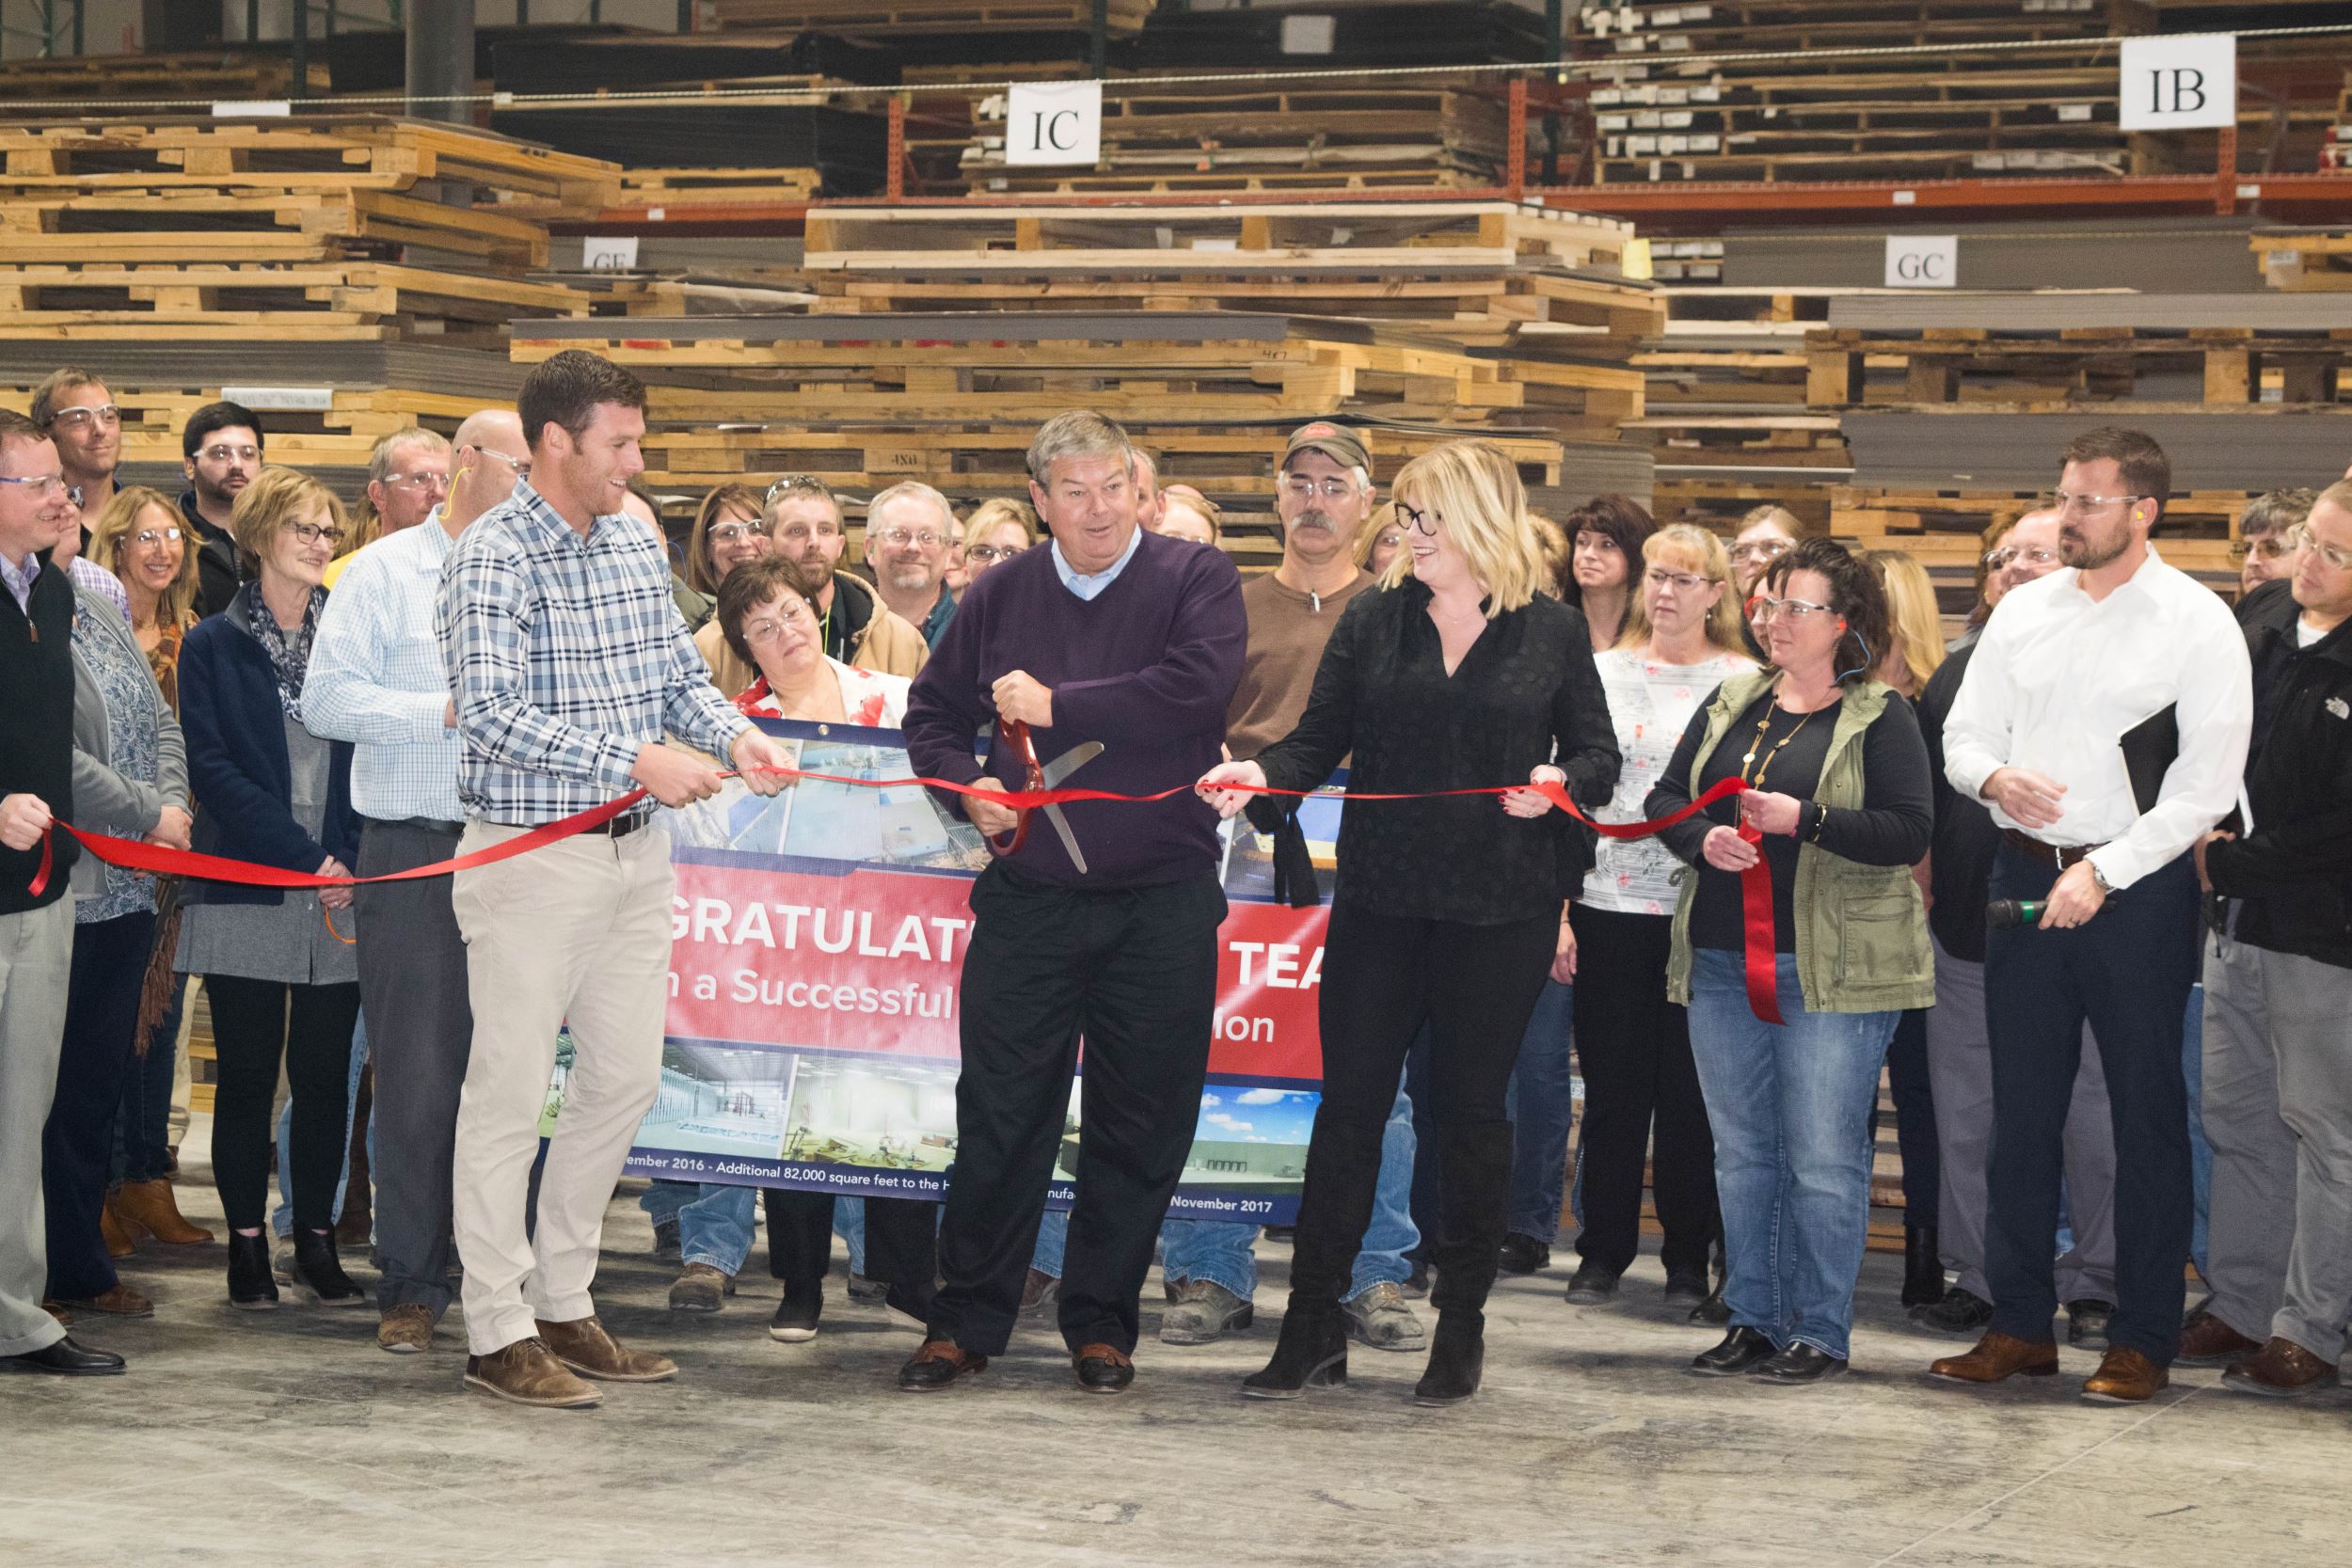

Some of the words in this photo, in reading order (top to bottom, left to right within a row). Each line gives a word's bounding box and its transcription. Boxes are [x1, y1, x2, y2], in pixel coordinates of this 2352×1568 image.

[2148, 68, 2206, 114] IB
[1030, 110, 1079, 150] IC
[1899, 252, 1945, 280] GC
[693, 974, 717, 1001] a
[730, 969, 954, 1020] Successful
[672, 1157, 705, 1171] 2016
[716, 1161, 781, 1178] Additional
[784, 1167, 826, 1182] 82,000
[829, 1173, 871, 1186] square
[873, 1174, 898, 1188] feet
[901, 1178, 915, 1189] to
[918, 1178, 940, 1191] the
[1169, 1196, 1238, 1212] November
[1240, 1199, 1273, 1213] 2017
